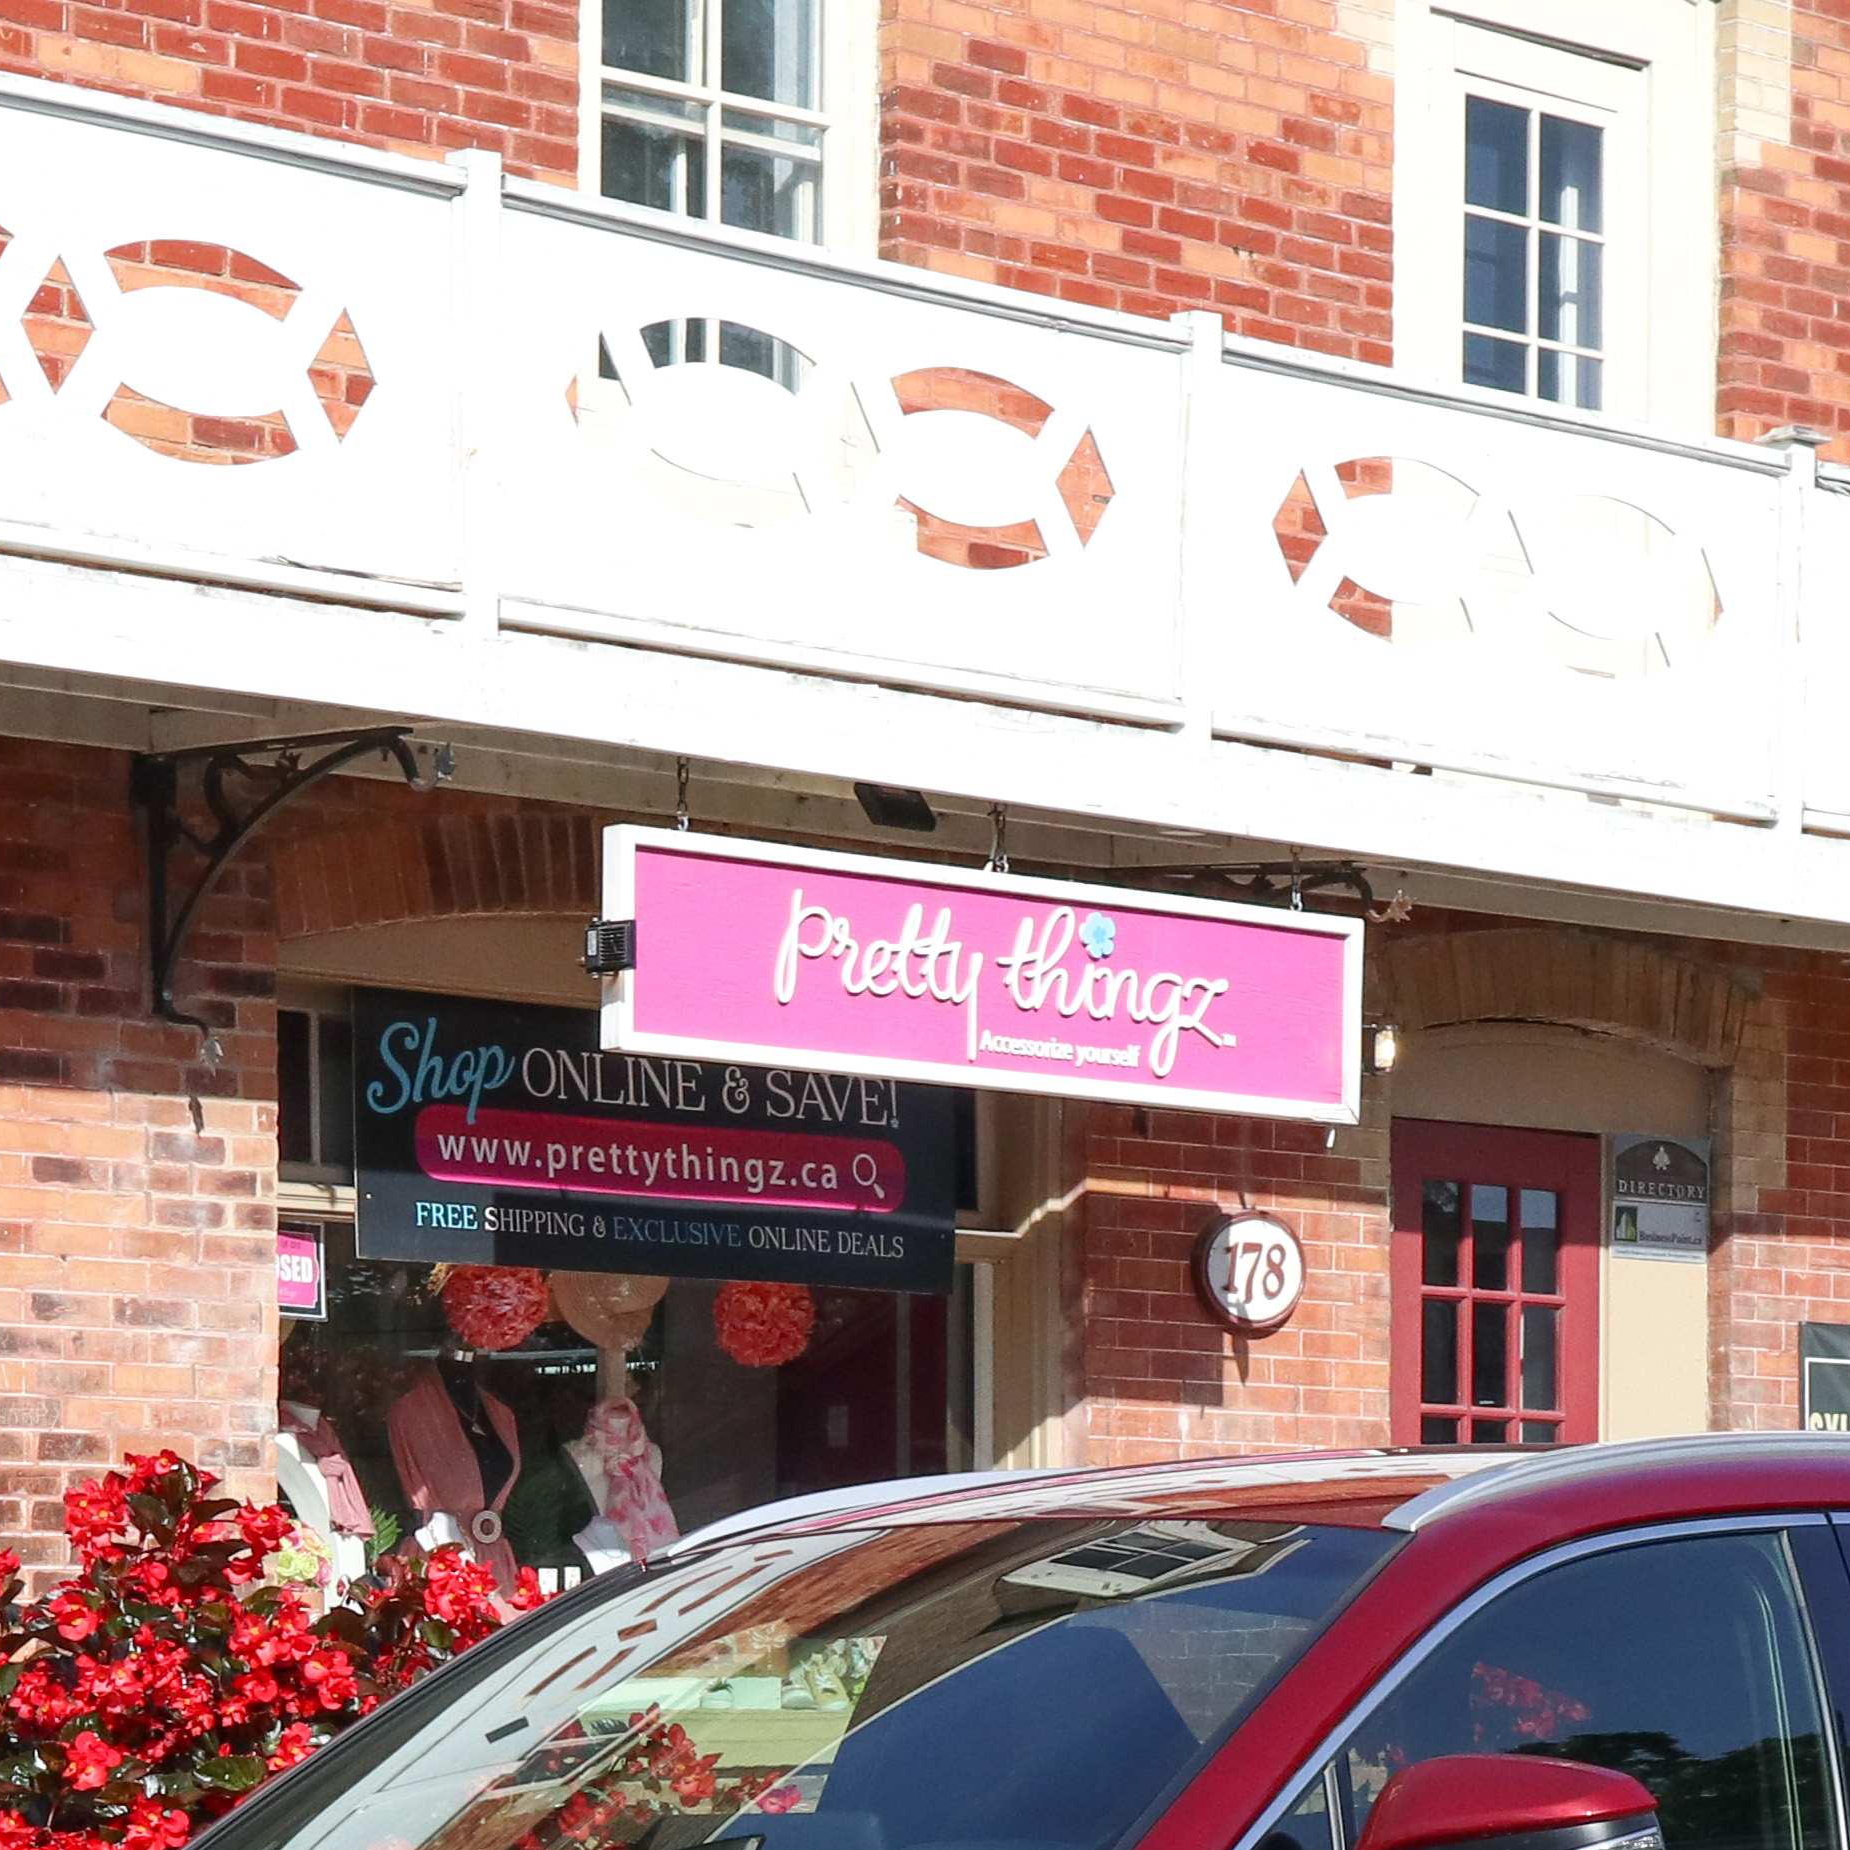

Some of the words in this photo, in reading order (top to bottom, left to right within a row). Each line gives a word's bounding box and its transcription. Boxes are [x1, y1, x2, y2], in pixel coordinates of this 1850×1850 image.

[774, 888, 983, 1061] pretty
[996, 905, 1229, 1078] thingz
[367, 1017, 515, 1124] Shop
[521, 1047, 705, 1112] ONLINE
[722, 1067, 750, 1114] &
[765, 1068, 900, 1129] SAVE!
[979, 1029, 1073, 1061] Accessorize
[1075, 1038, 1141, 1068] yourself
[437, 1131, 839, 1194] www.prettythingz.ca
[1618, 1179, 1705, 1199] DIRECTORY
[416, 1201, 477, 1231] FREE
[484, 1206, 584, 1238] SHIPPING
[593, 1214, 606, 1238] &
[613, 1216, 741, 1248] EXCLUSIVE
[748, 1225, 831, 1253] ONLINE
[838, 1231, 905, 1259] DEALS
[276, 1254, 313, 1283] SED
[1223, 1242, 1286, 1304] 178
